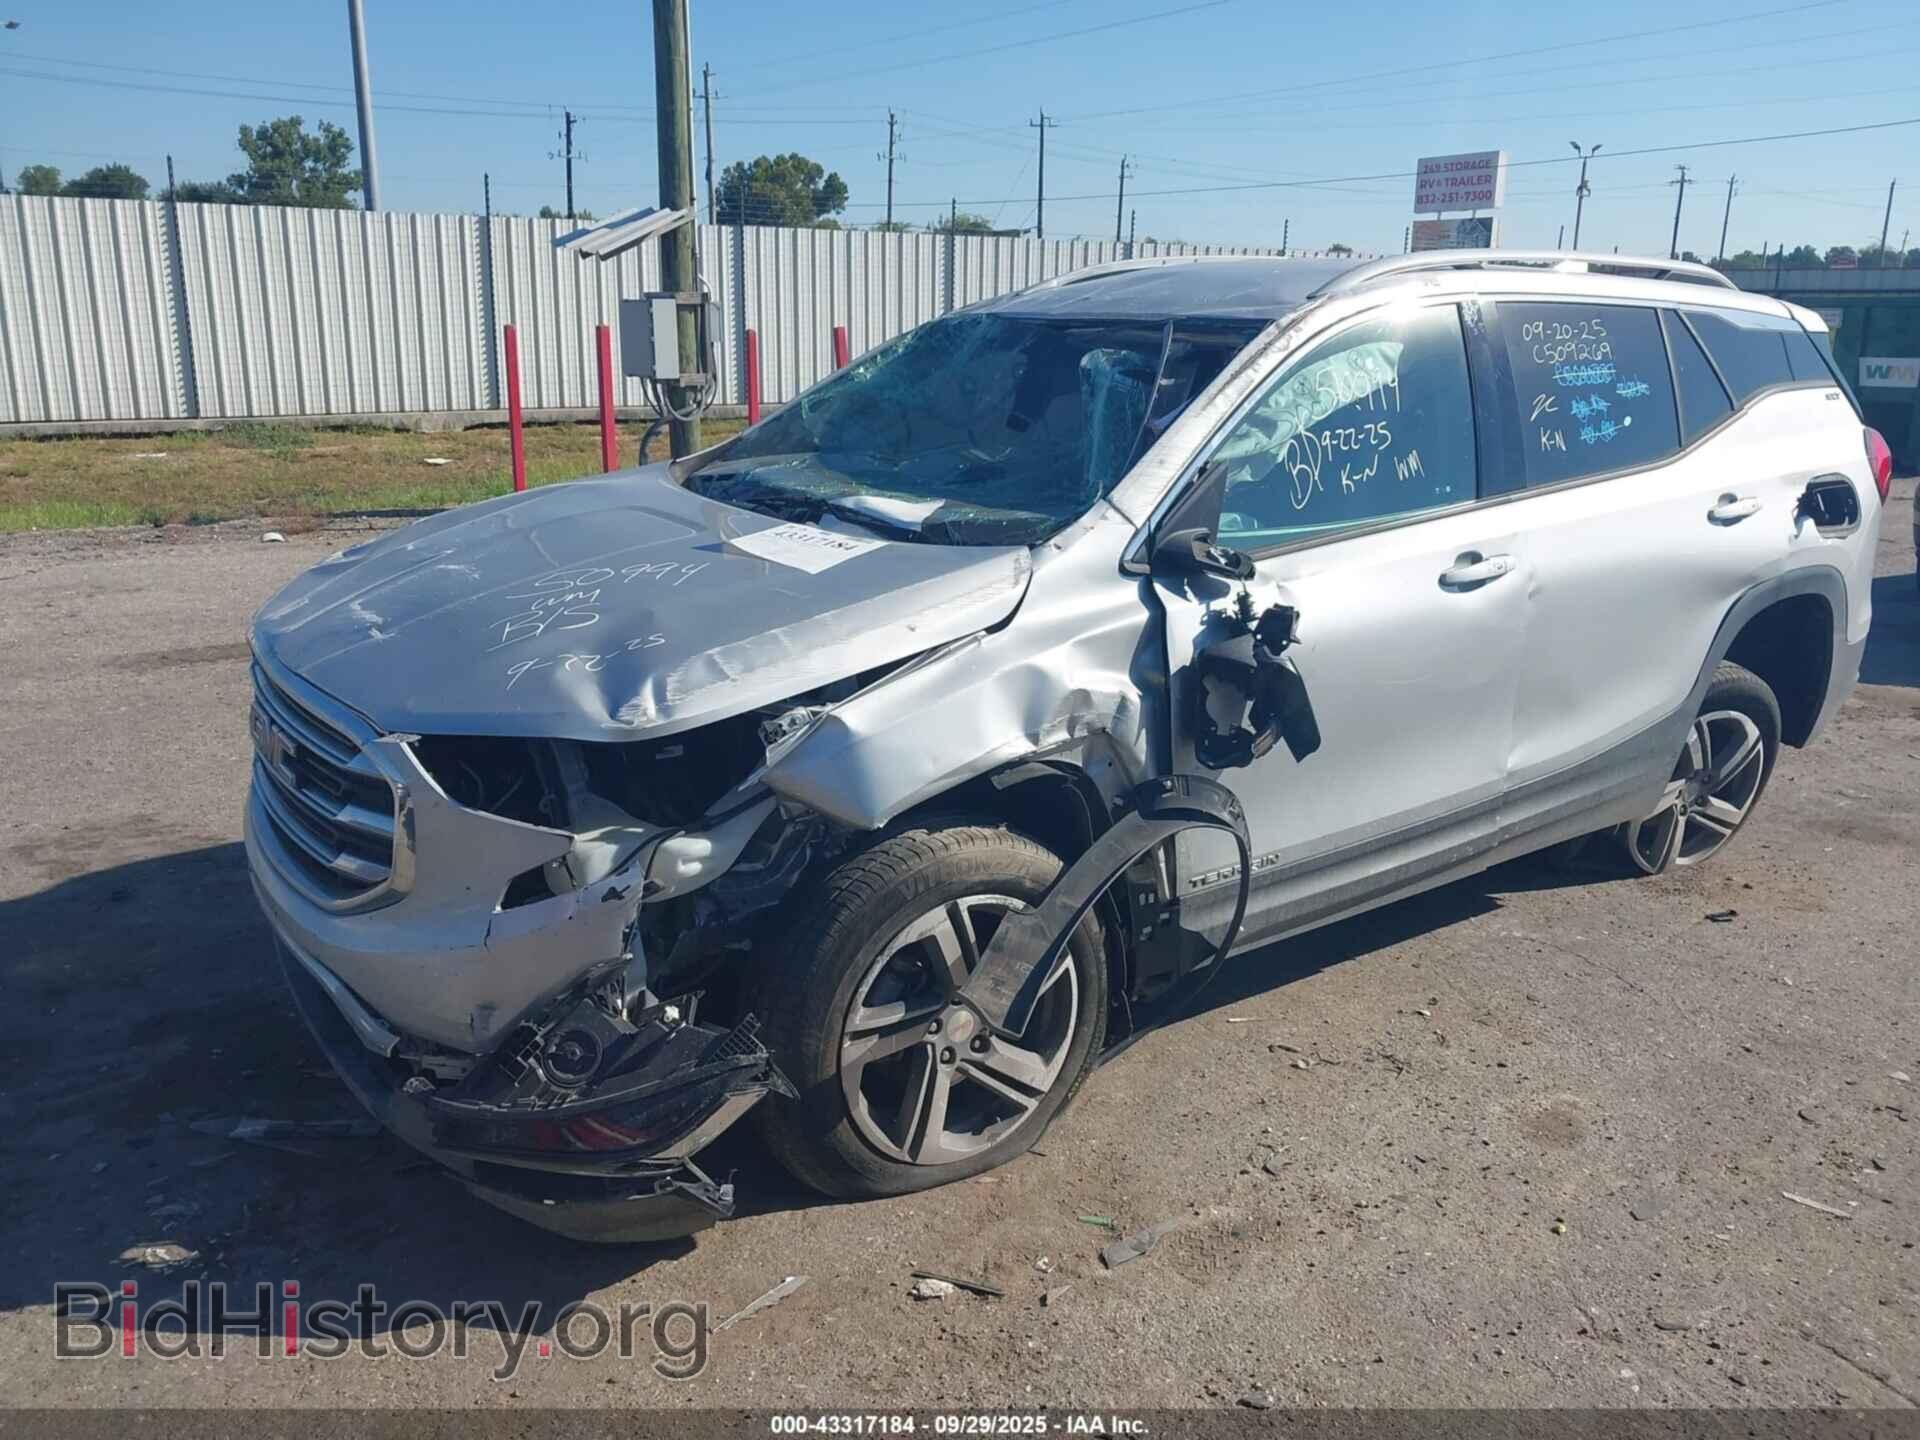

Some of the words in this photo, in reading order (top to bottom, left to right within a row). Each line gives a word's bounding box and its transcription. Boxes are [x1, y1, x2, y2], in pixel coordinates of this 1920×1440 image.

[1443, 159, 1490, 172] STORAGE
[1445, 174, 1492, 187] TRAILER
[1522, 319, 1607, 341] 09-20-25
[1321, 421, 1392, 462] 9-22-25
